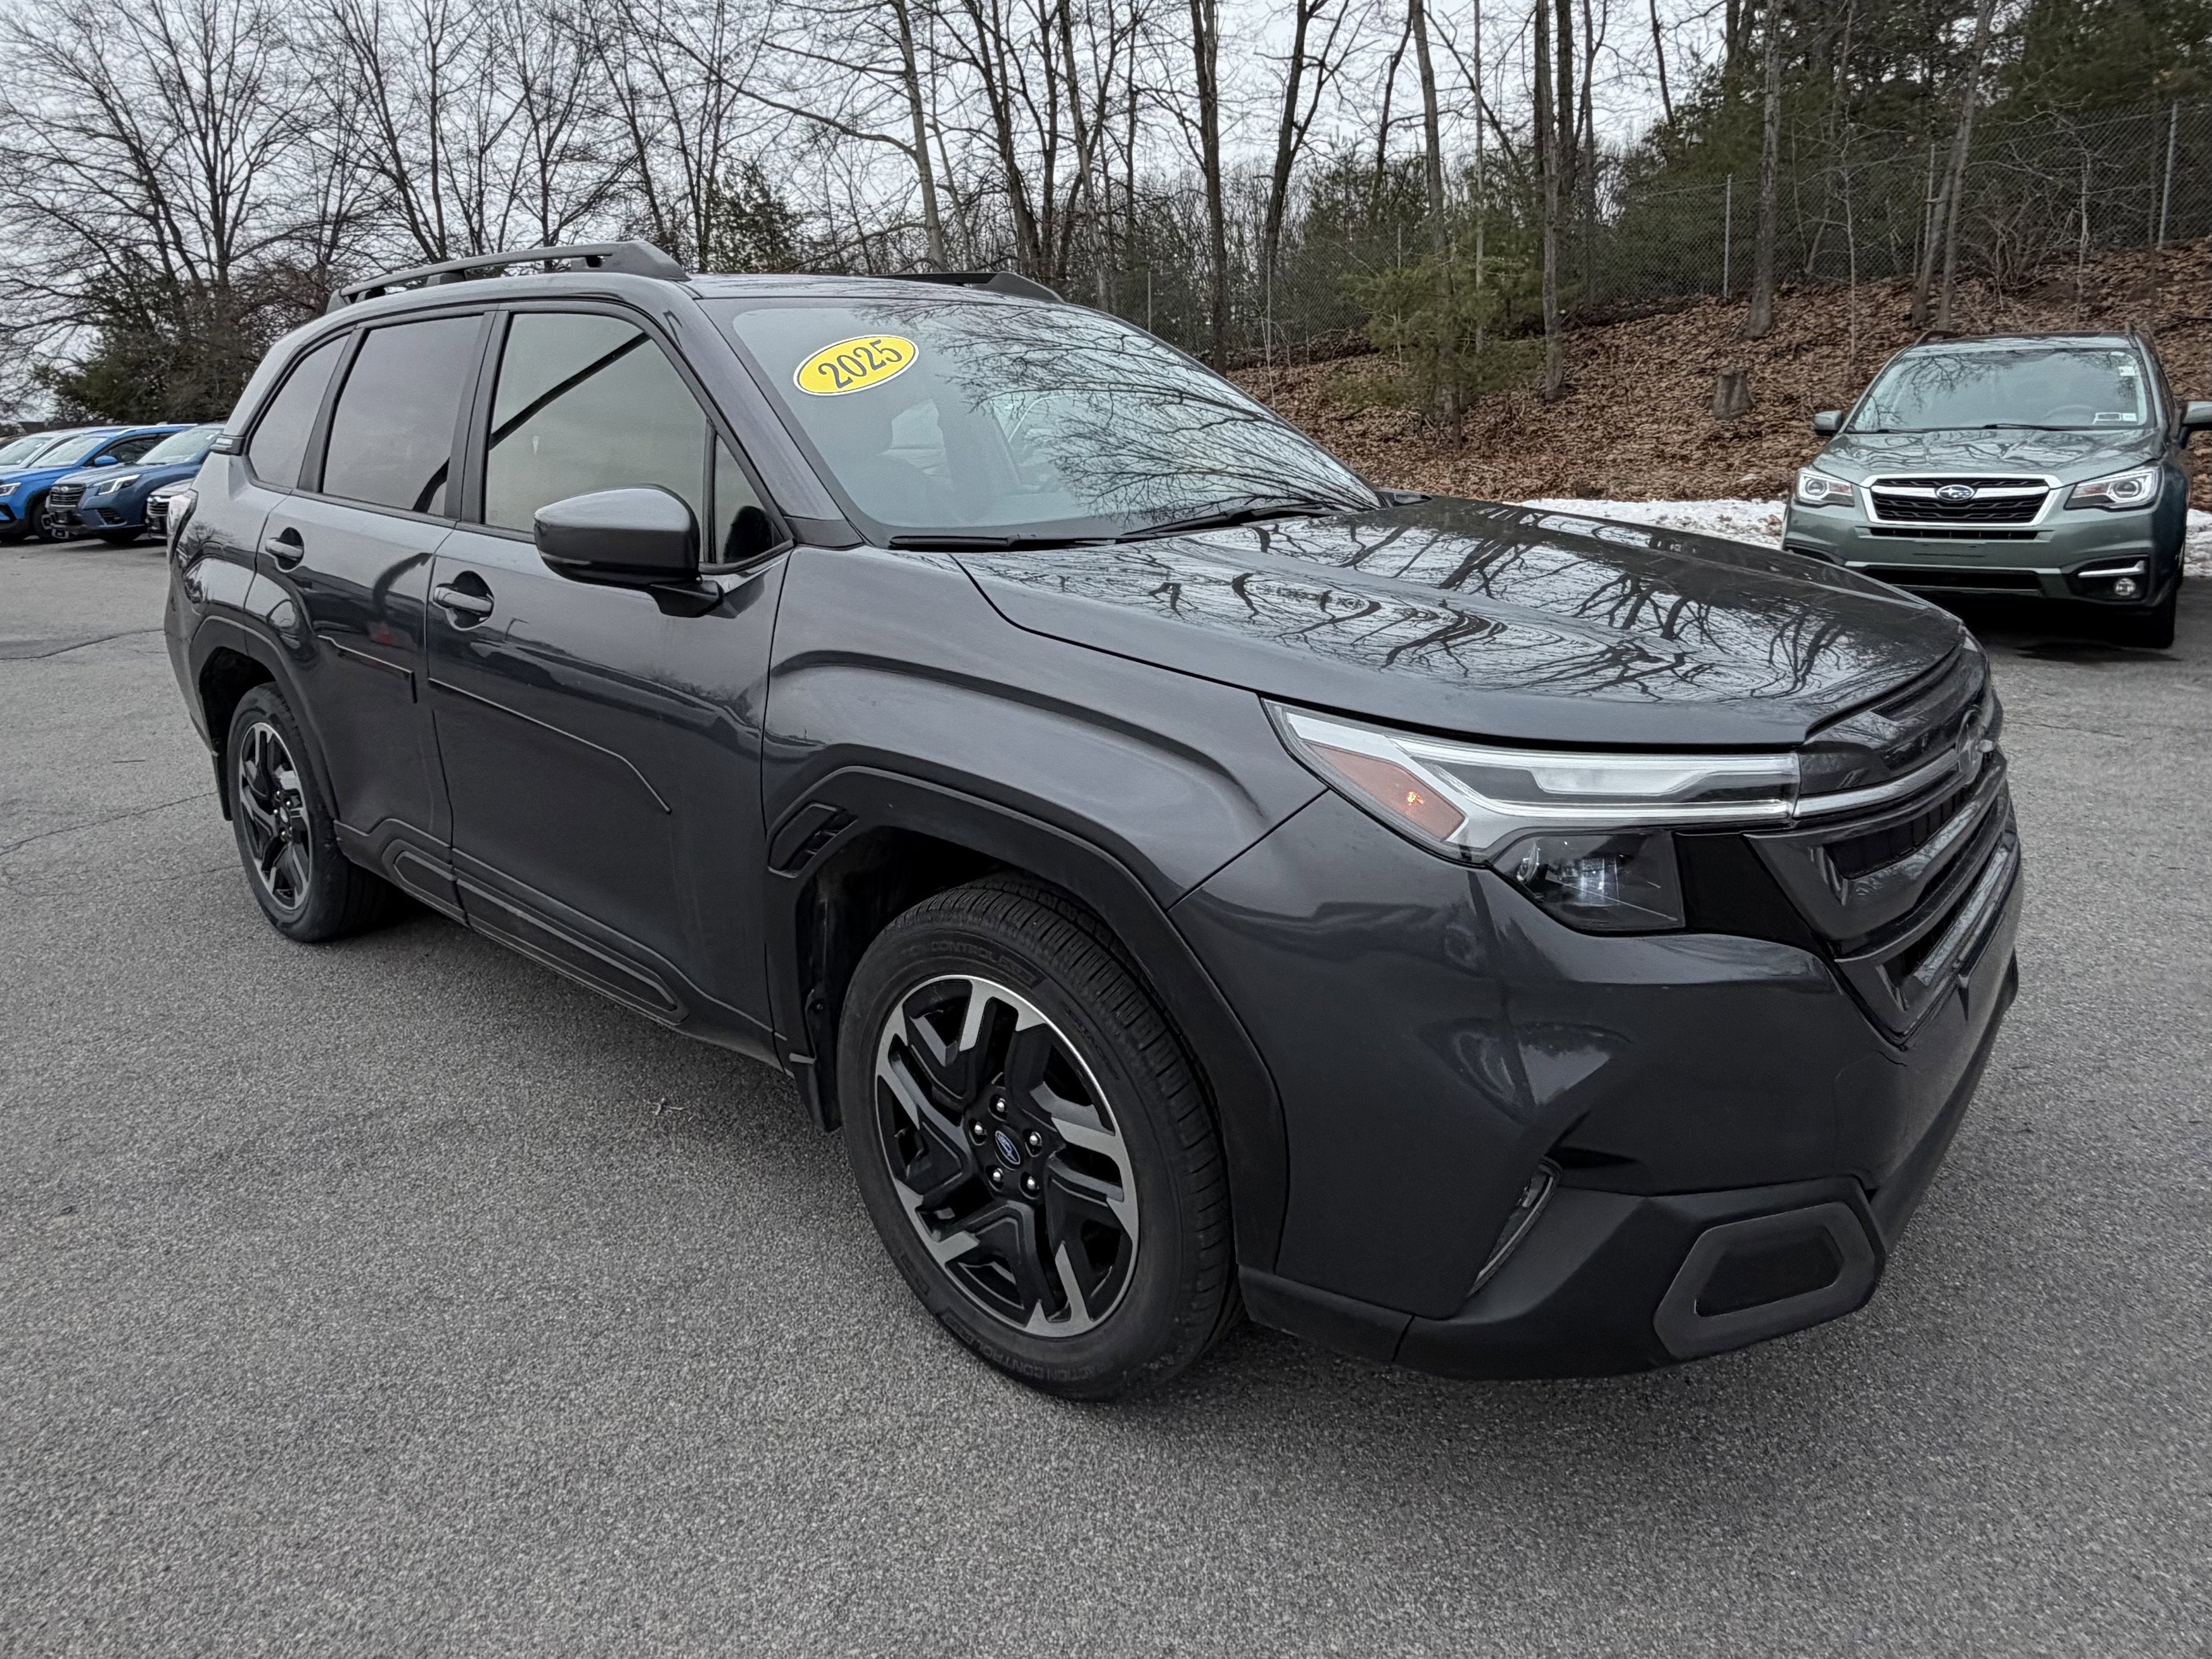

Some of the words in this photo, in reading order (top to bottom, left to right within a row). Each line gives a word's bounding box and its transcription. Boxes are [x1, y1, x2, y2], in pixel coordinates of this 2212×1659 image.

[818, 339, 902, 389] 2025
[932, 940, 998, 964] CONTROL
[977, 1339, 1044, 1379] CONTROL
